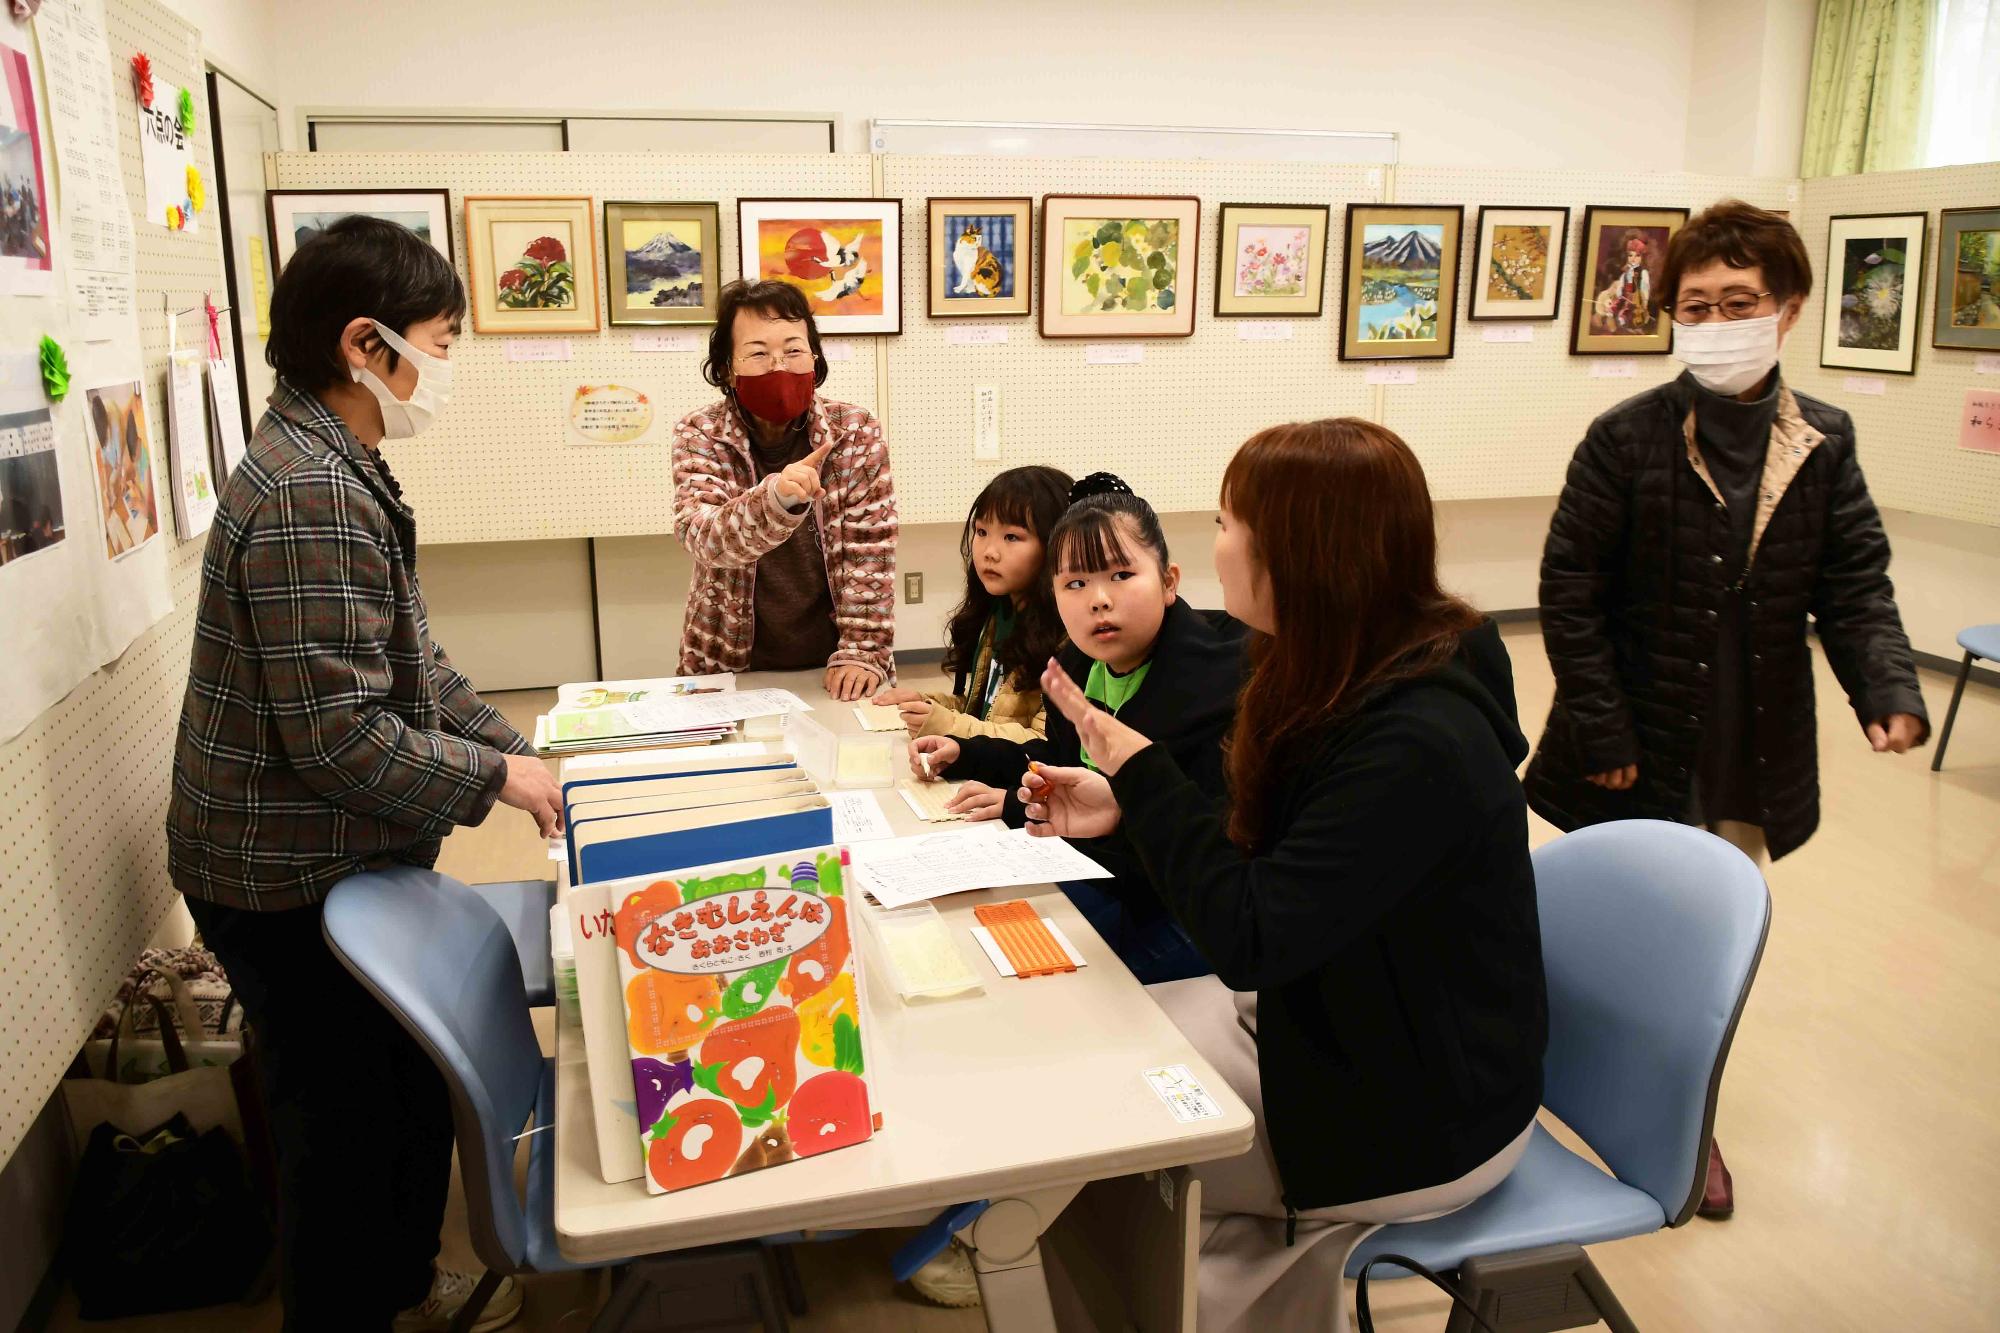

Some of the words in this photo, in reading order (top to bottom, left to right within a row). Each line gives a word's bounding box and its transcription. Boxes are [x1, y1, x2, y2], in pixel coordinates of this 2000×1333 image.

[1969, 415, 2000, 430] 和ら
[644, 891, 823, 954] なきむしえんは
[691, 922, 792, 959] おおさわぎ
